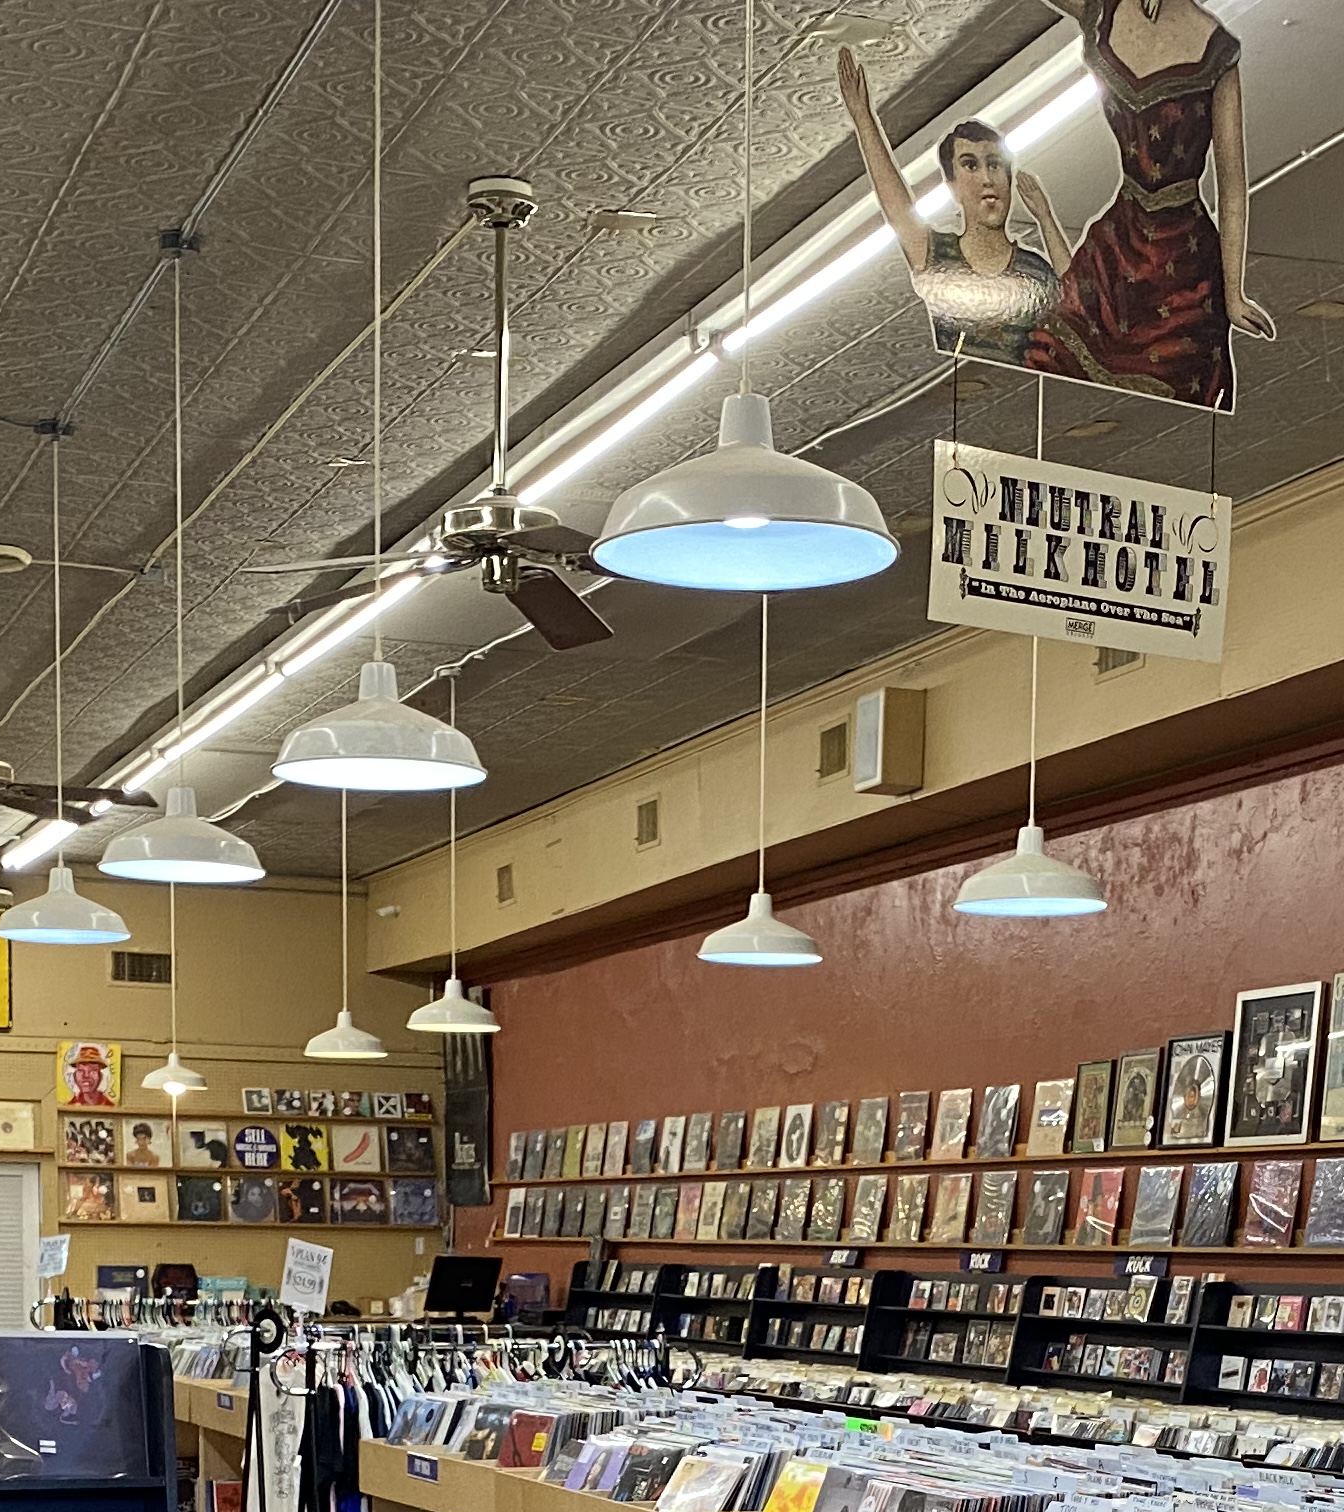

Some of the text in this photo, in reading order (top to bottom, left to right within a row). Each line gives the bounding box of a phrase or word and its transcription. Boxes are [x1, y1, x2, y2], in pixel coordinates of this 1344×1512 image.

[999, 476, 1169, 550] NEUTRAL
[942, 516, 1219, 605] MILK HOTEL
[999, 585, 1026, 600] The
[1029, 591, 1097, 612] Aeroplane
[1101, 602, 1131, 616] Over
[1134, 607, 1158, 621] The
[1067, 620, 1094, 633] MERGE
[1125, 1256, 1153, 1273] ROCK
